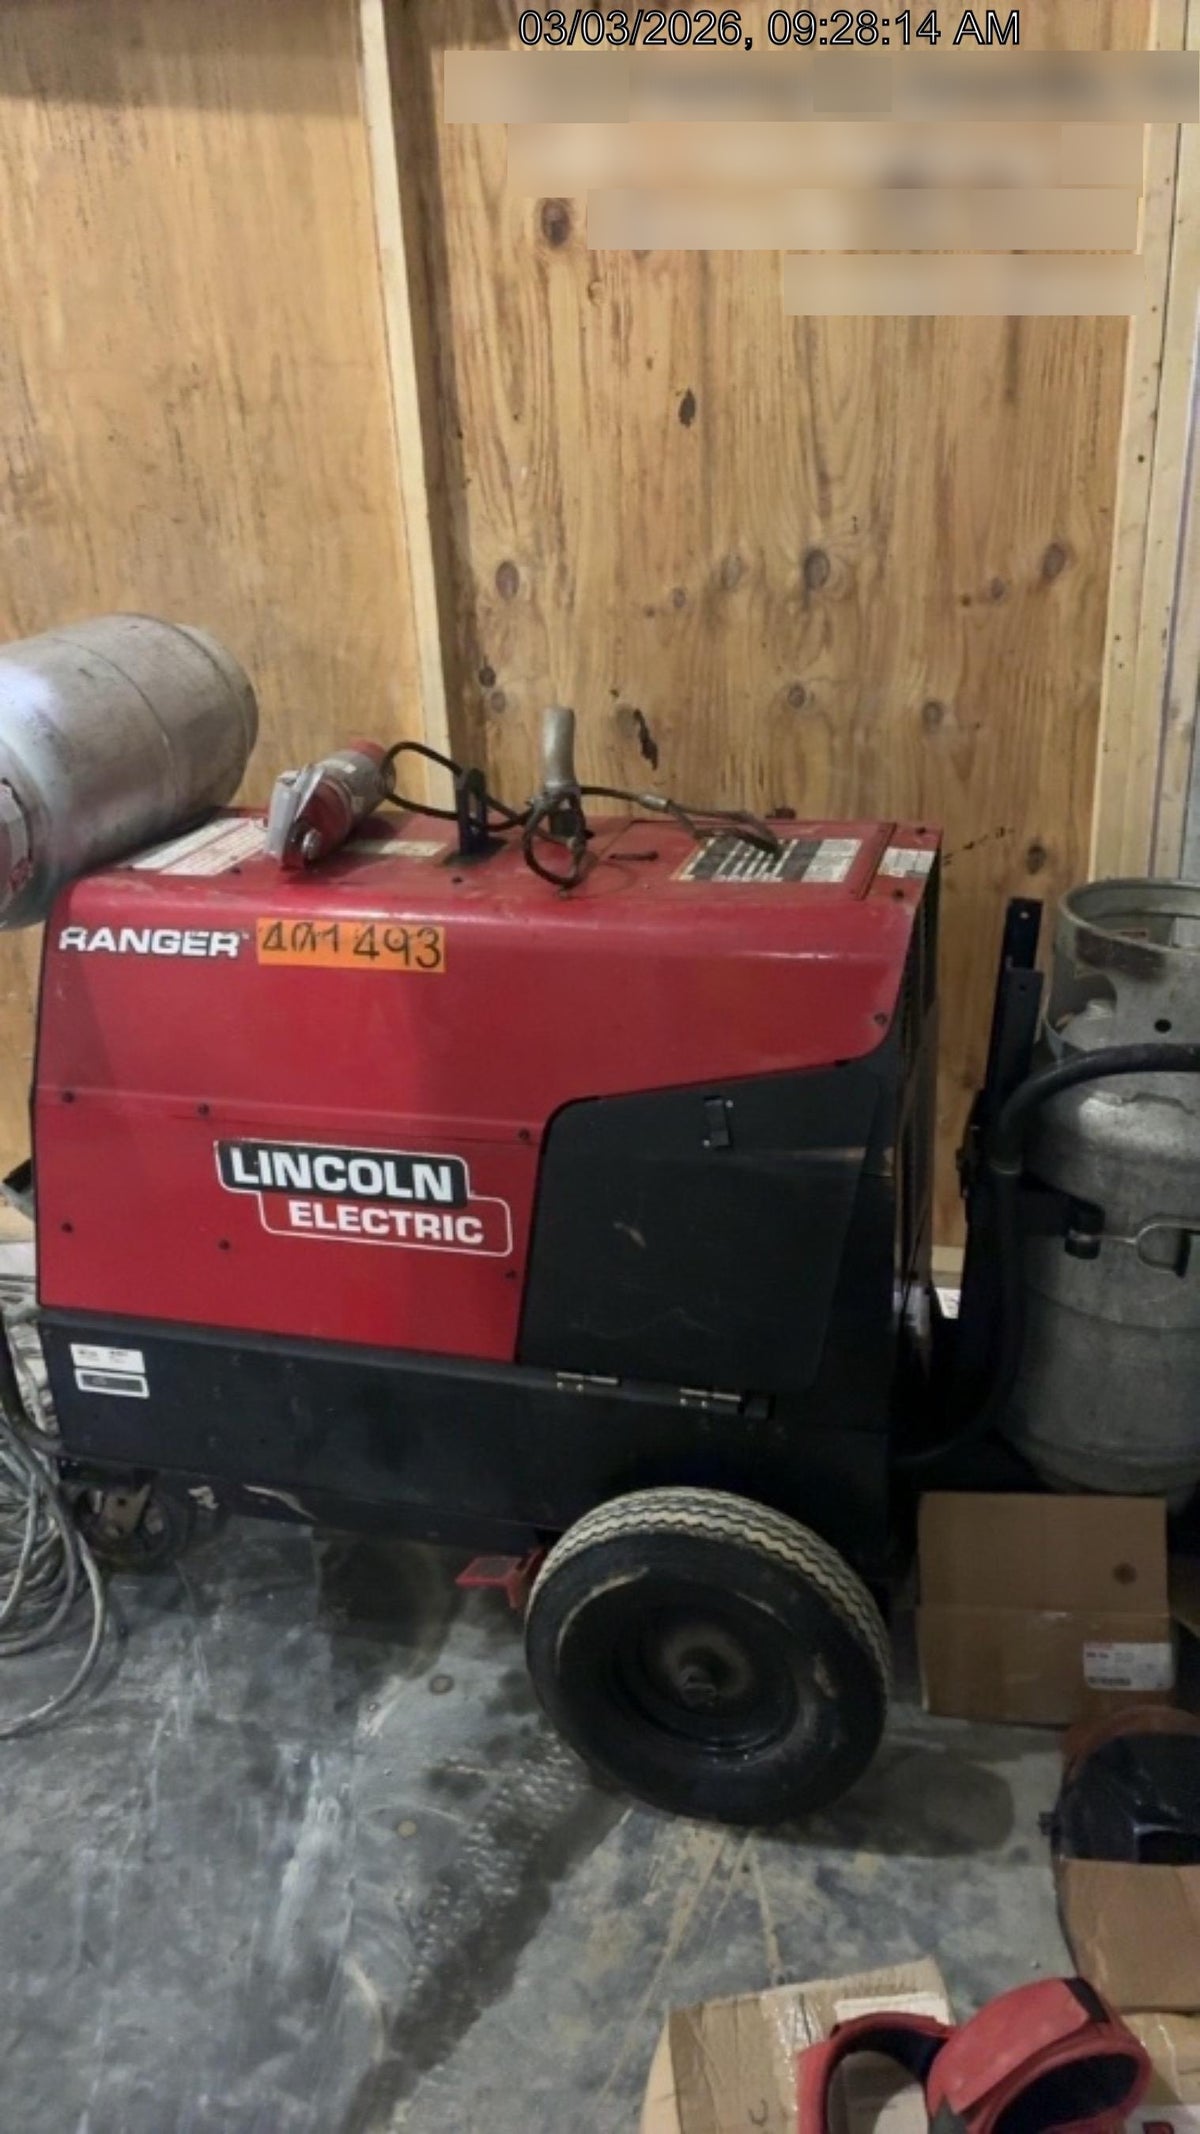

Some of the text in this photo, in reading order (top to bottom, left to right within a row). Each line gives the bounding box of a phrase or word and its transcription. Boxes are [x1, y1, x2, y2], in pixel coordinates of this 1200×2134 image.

[58, 926, 240, 957] RANGER
[230, 1147, 453, 1202] LINCOLN
[288, 1200, 484, 1244] ELECTRIC
